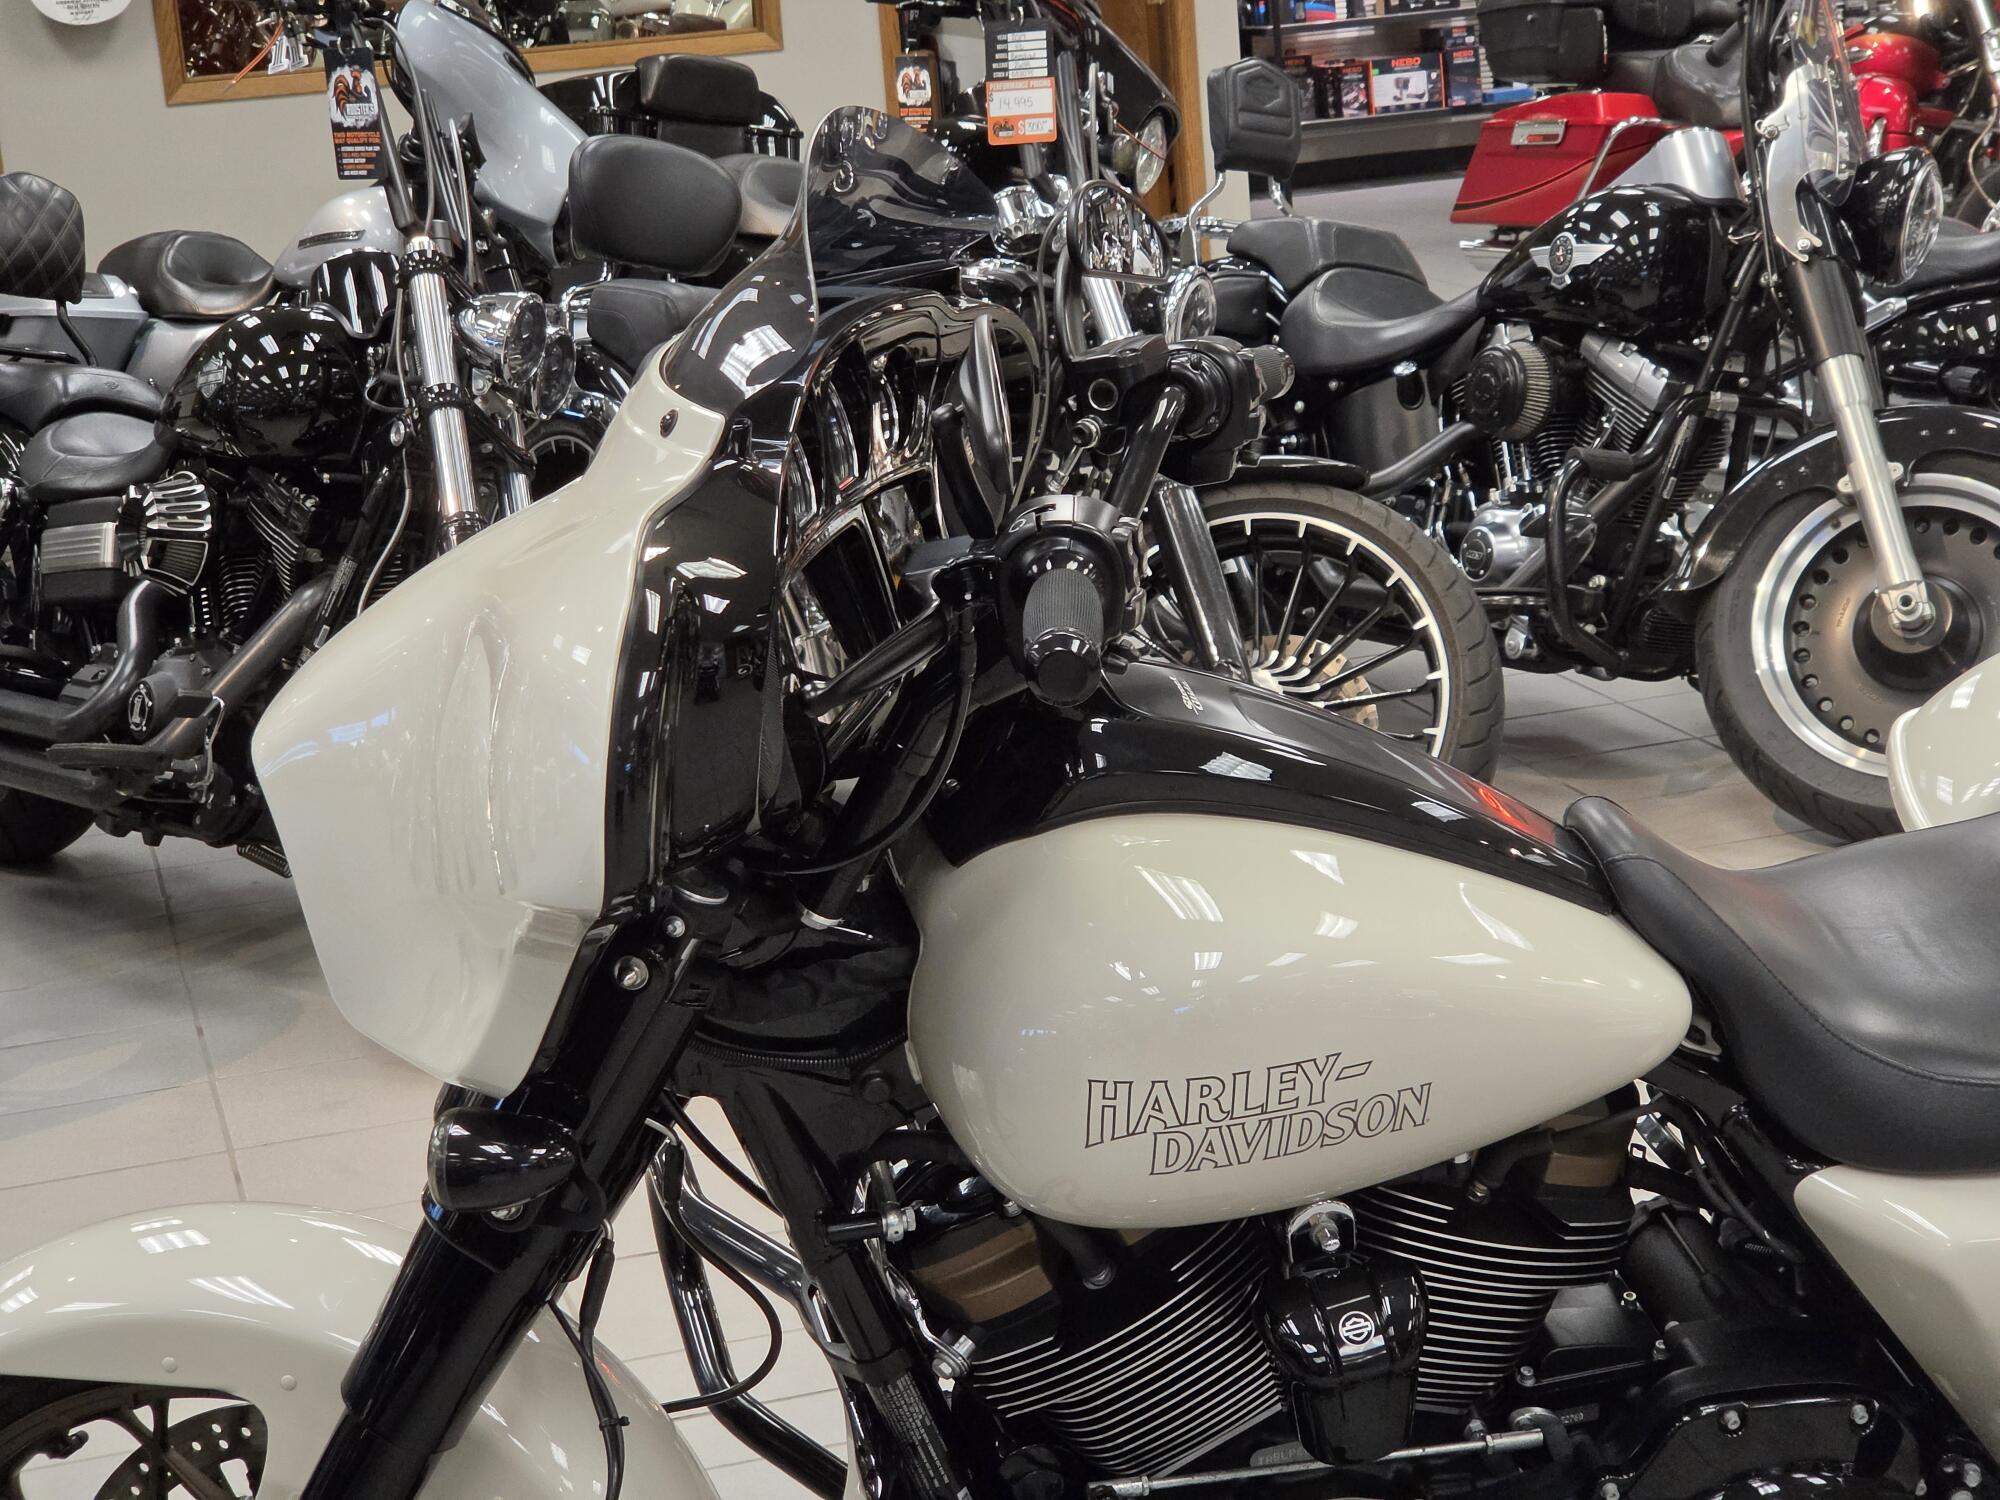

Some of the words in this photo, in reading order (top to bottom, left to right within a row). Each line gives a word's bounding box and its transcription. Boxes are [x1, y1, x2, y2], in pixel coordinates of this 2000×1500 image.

[1391, 56, 1421, 67] NEBO
[1085, 1052, 1373, 1149] HARLEY-
[1149, 1082, 1432, 1176] DAVIDSON
